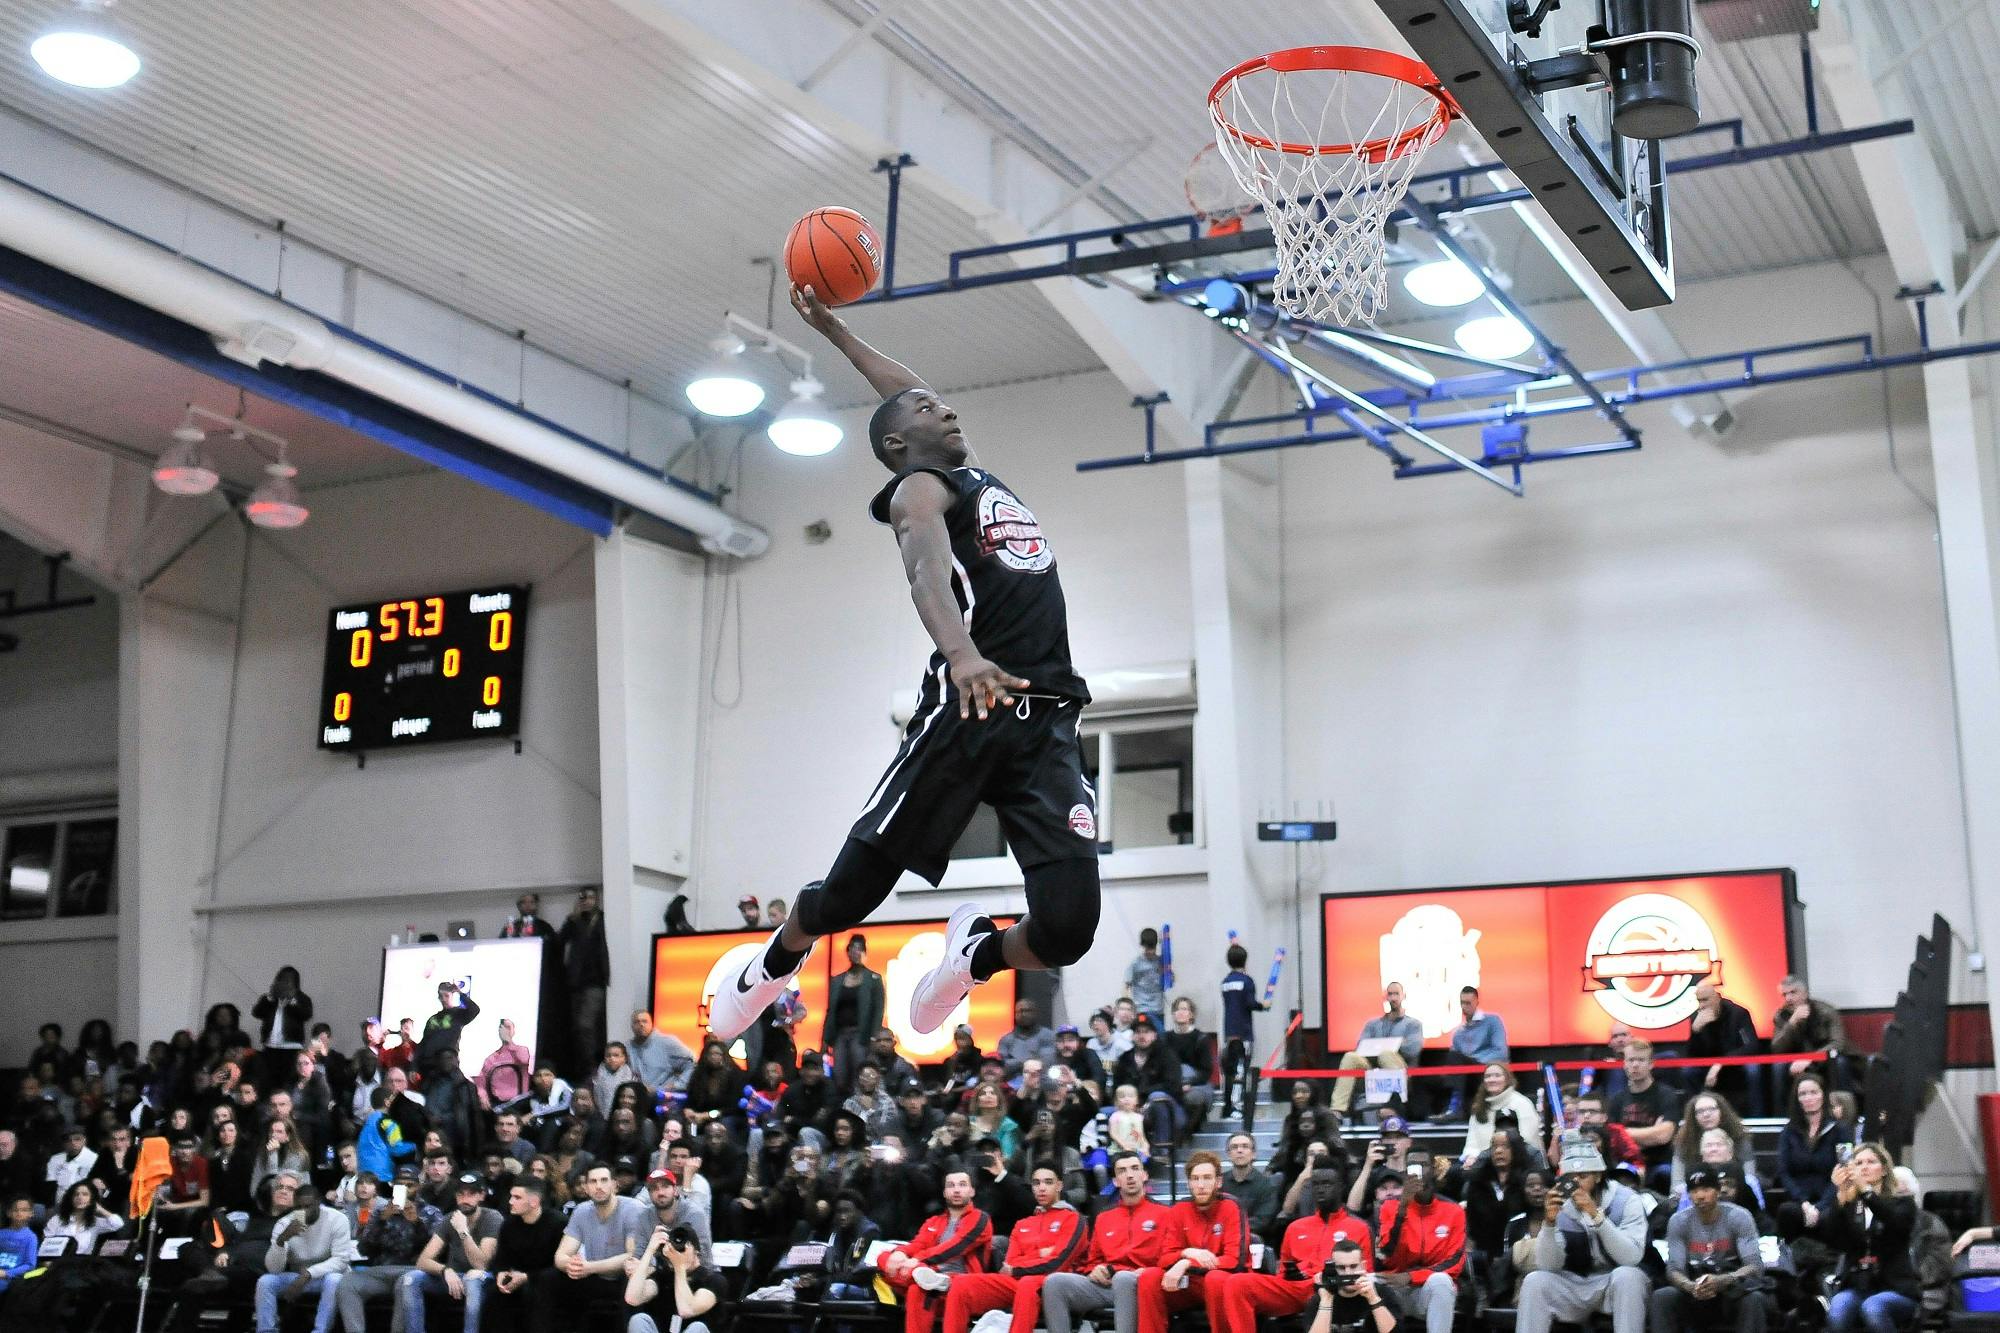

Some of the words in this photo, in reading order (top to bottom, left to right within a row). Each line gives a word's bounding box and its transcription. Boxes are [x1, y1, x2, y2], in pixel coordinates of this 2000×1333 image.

[379, 597, 445, 642] 57.3
[489, 611, 512, 651] 0
[350, 629, 373, 668] 0
[442, 648, 461, 678] 0
[397, 659, 434, 680] period
[482, 676, 501, 706] 0
[333, 692, 352, 721] 0
